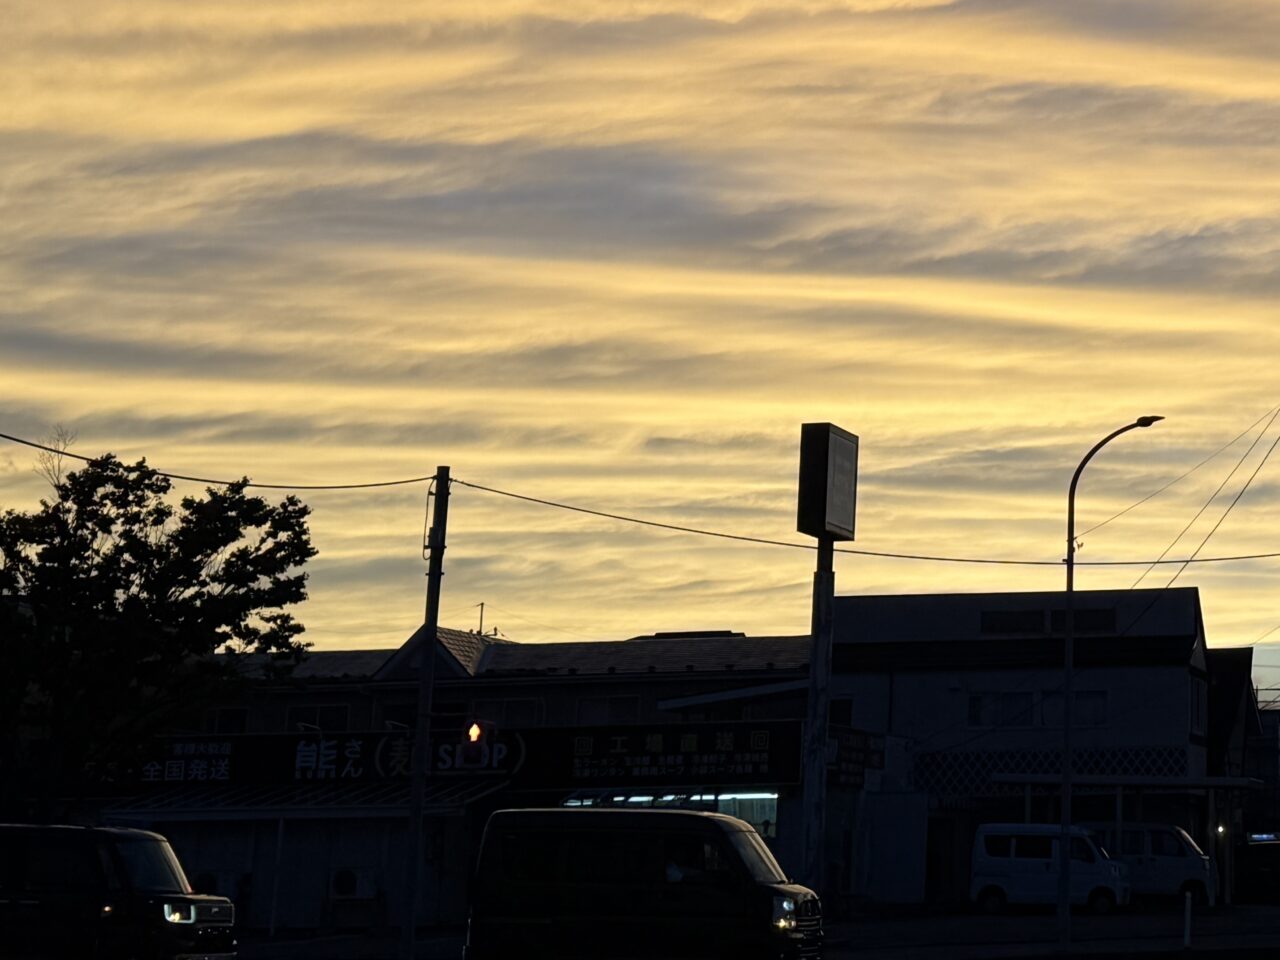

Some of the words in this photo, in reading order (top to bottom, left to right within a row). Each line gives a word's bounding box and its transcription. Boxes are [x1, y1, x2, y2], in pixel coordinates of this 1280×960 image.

[143, 758, 232, 783] 全国発送
[295, 739, 364, 779] 熊さん
